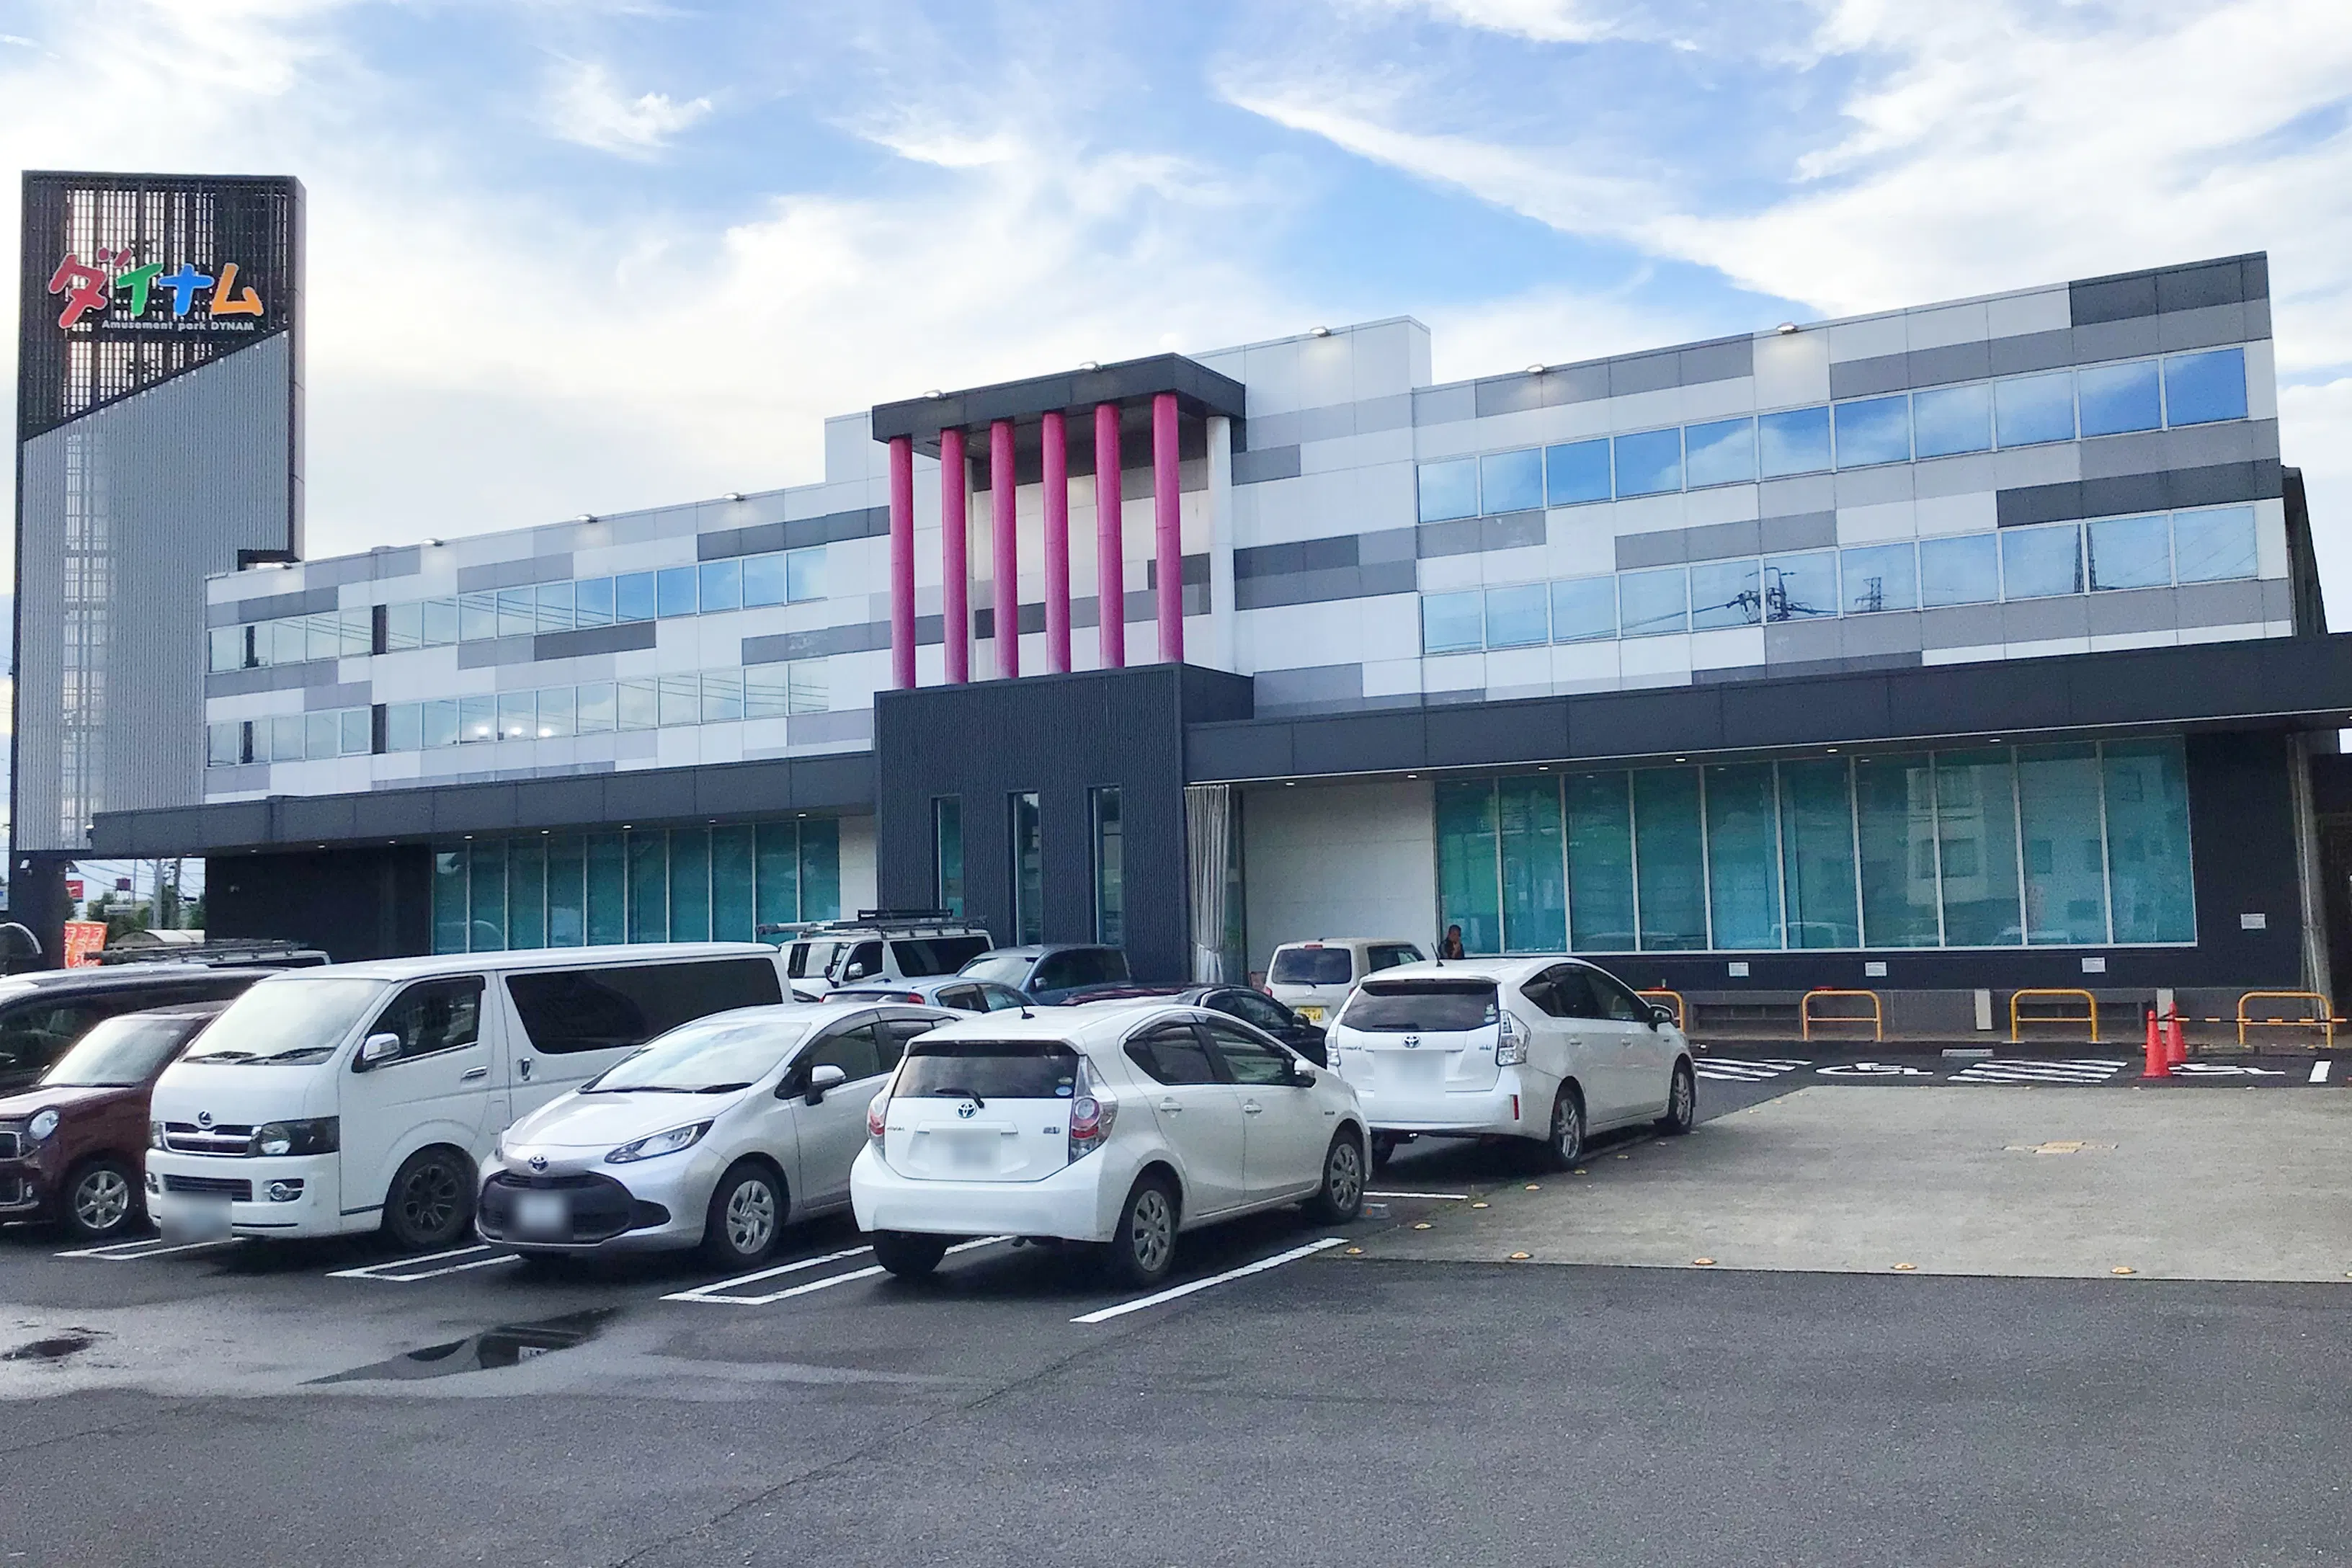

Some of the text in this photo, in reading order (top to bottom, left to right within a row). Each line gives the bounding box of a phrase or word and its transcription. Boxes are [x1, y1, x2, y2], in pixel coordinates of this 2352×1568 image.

[48, 247, 264, 328] ダイナム
[102, 319, 254, 331] Amusement park DYNAM
